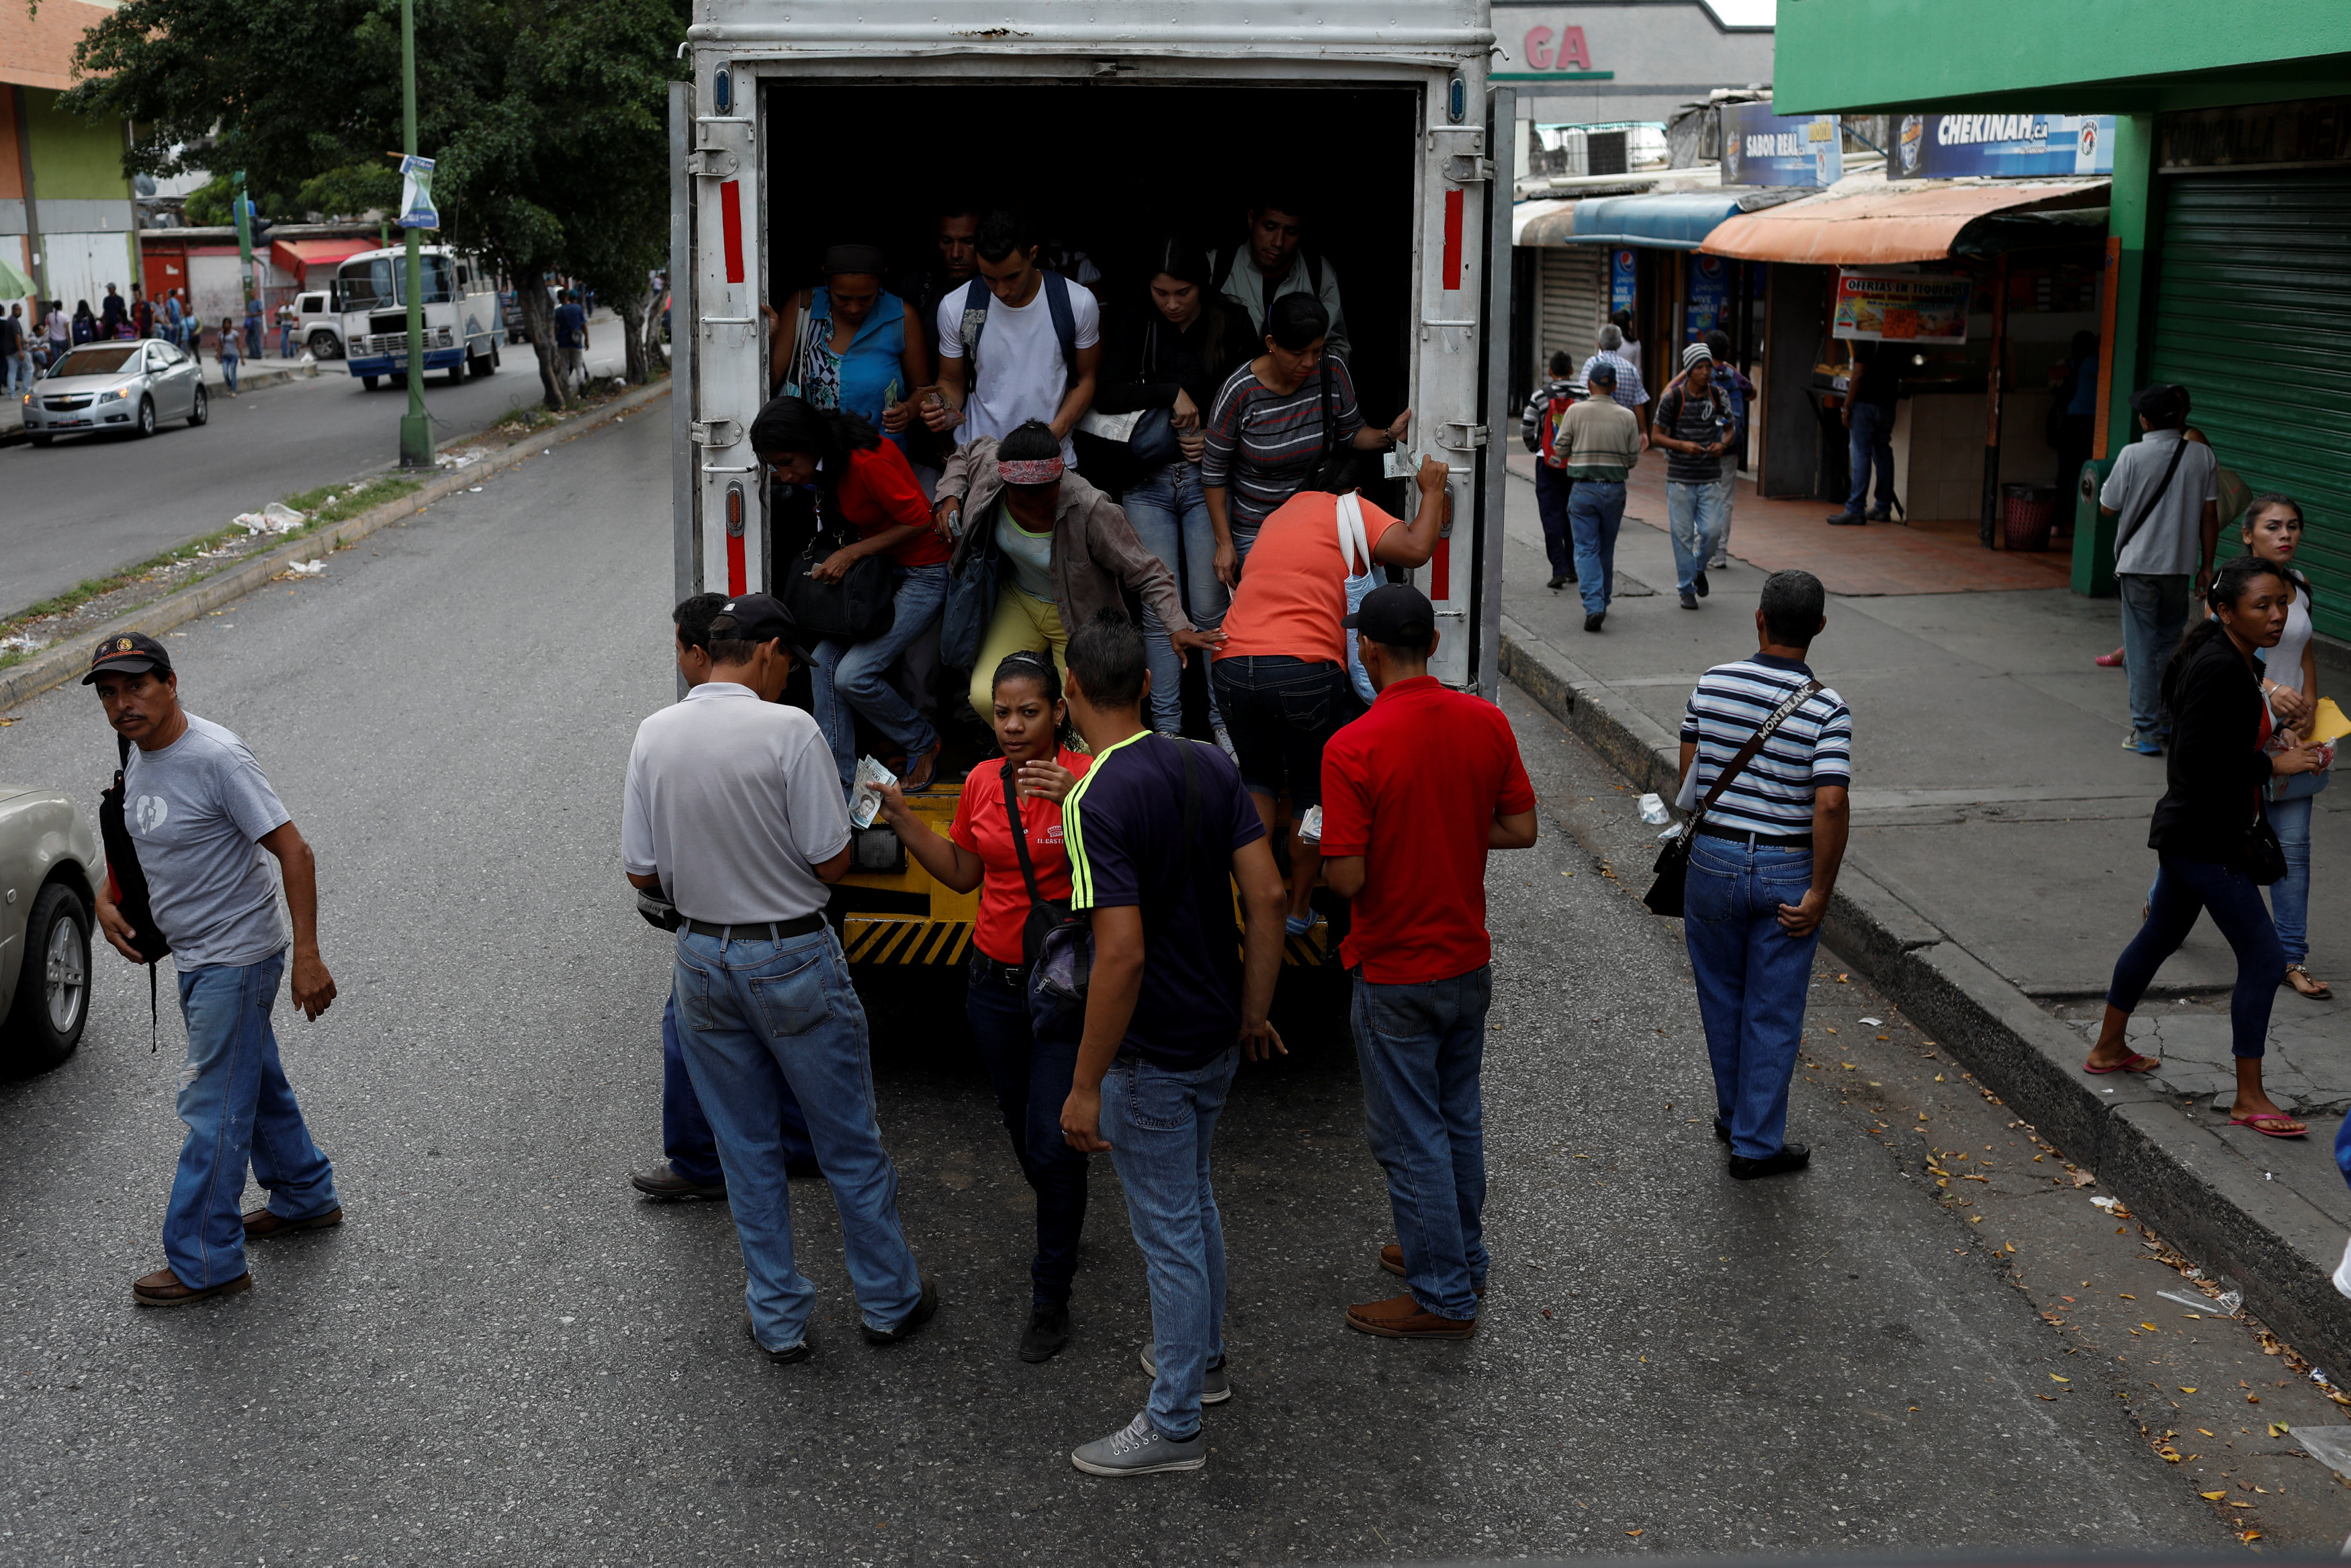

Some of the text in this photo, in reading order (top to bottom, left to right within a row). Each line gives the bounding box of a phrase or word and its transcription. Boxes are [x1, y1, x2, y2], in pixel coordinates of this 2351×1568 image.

[1746, 134, 1775, 158] SABOR
[1695, 283, 1724, 293] pepsi
[1849, 280, 1964, 295] OFERTAS EN TEQUEÑOS
[1692, 295, 1712, 304] VIVE
[1687, 304, 1718, 314] AHORA!
[1757, 684, 1814, 740] MONTBLANC
[871, 770, 881, 781] 500
